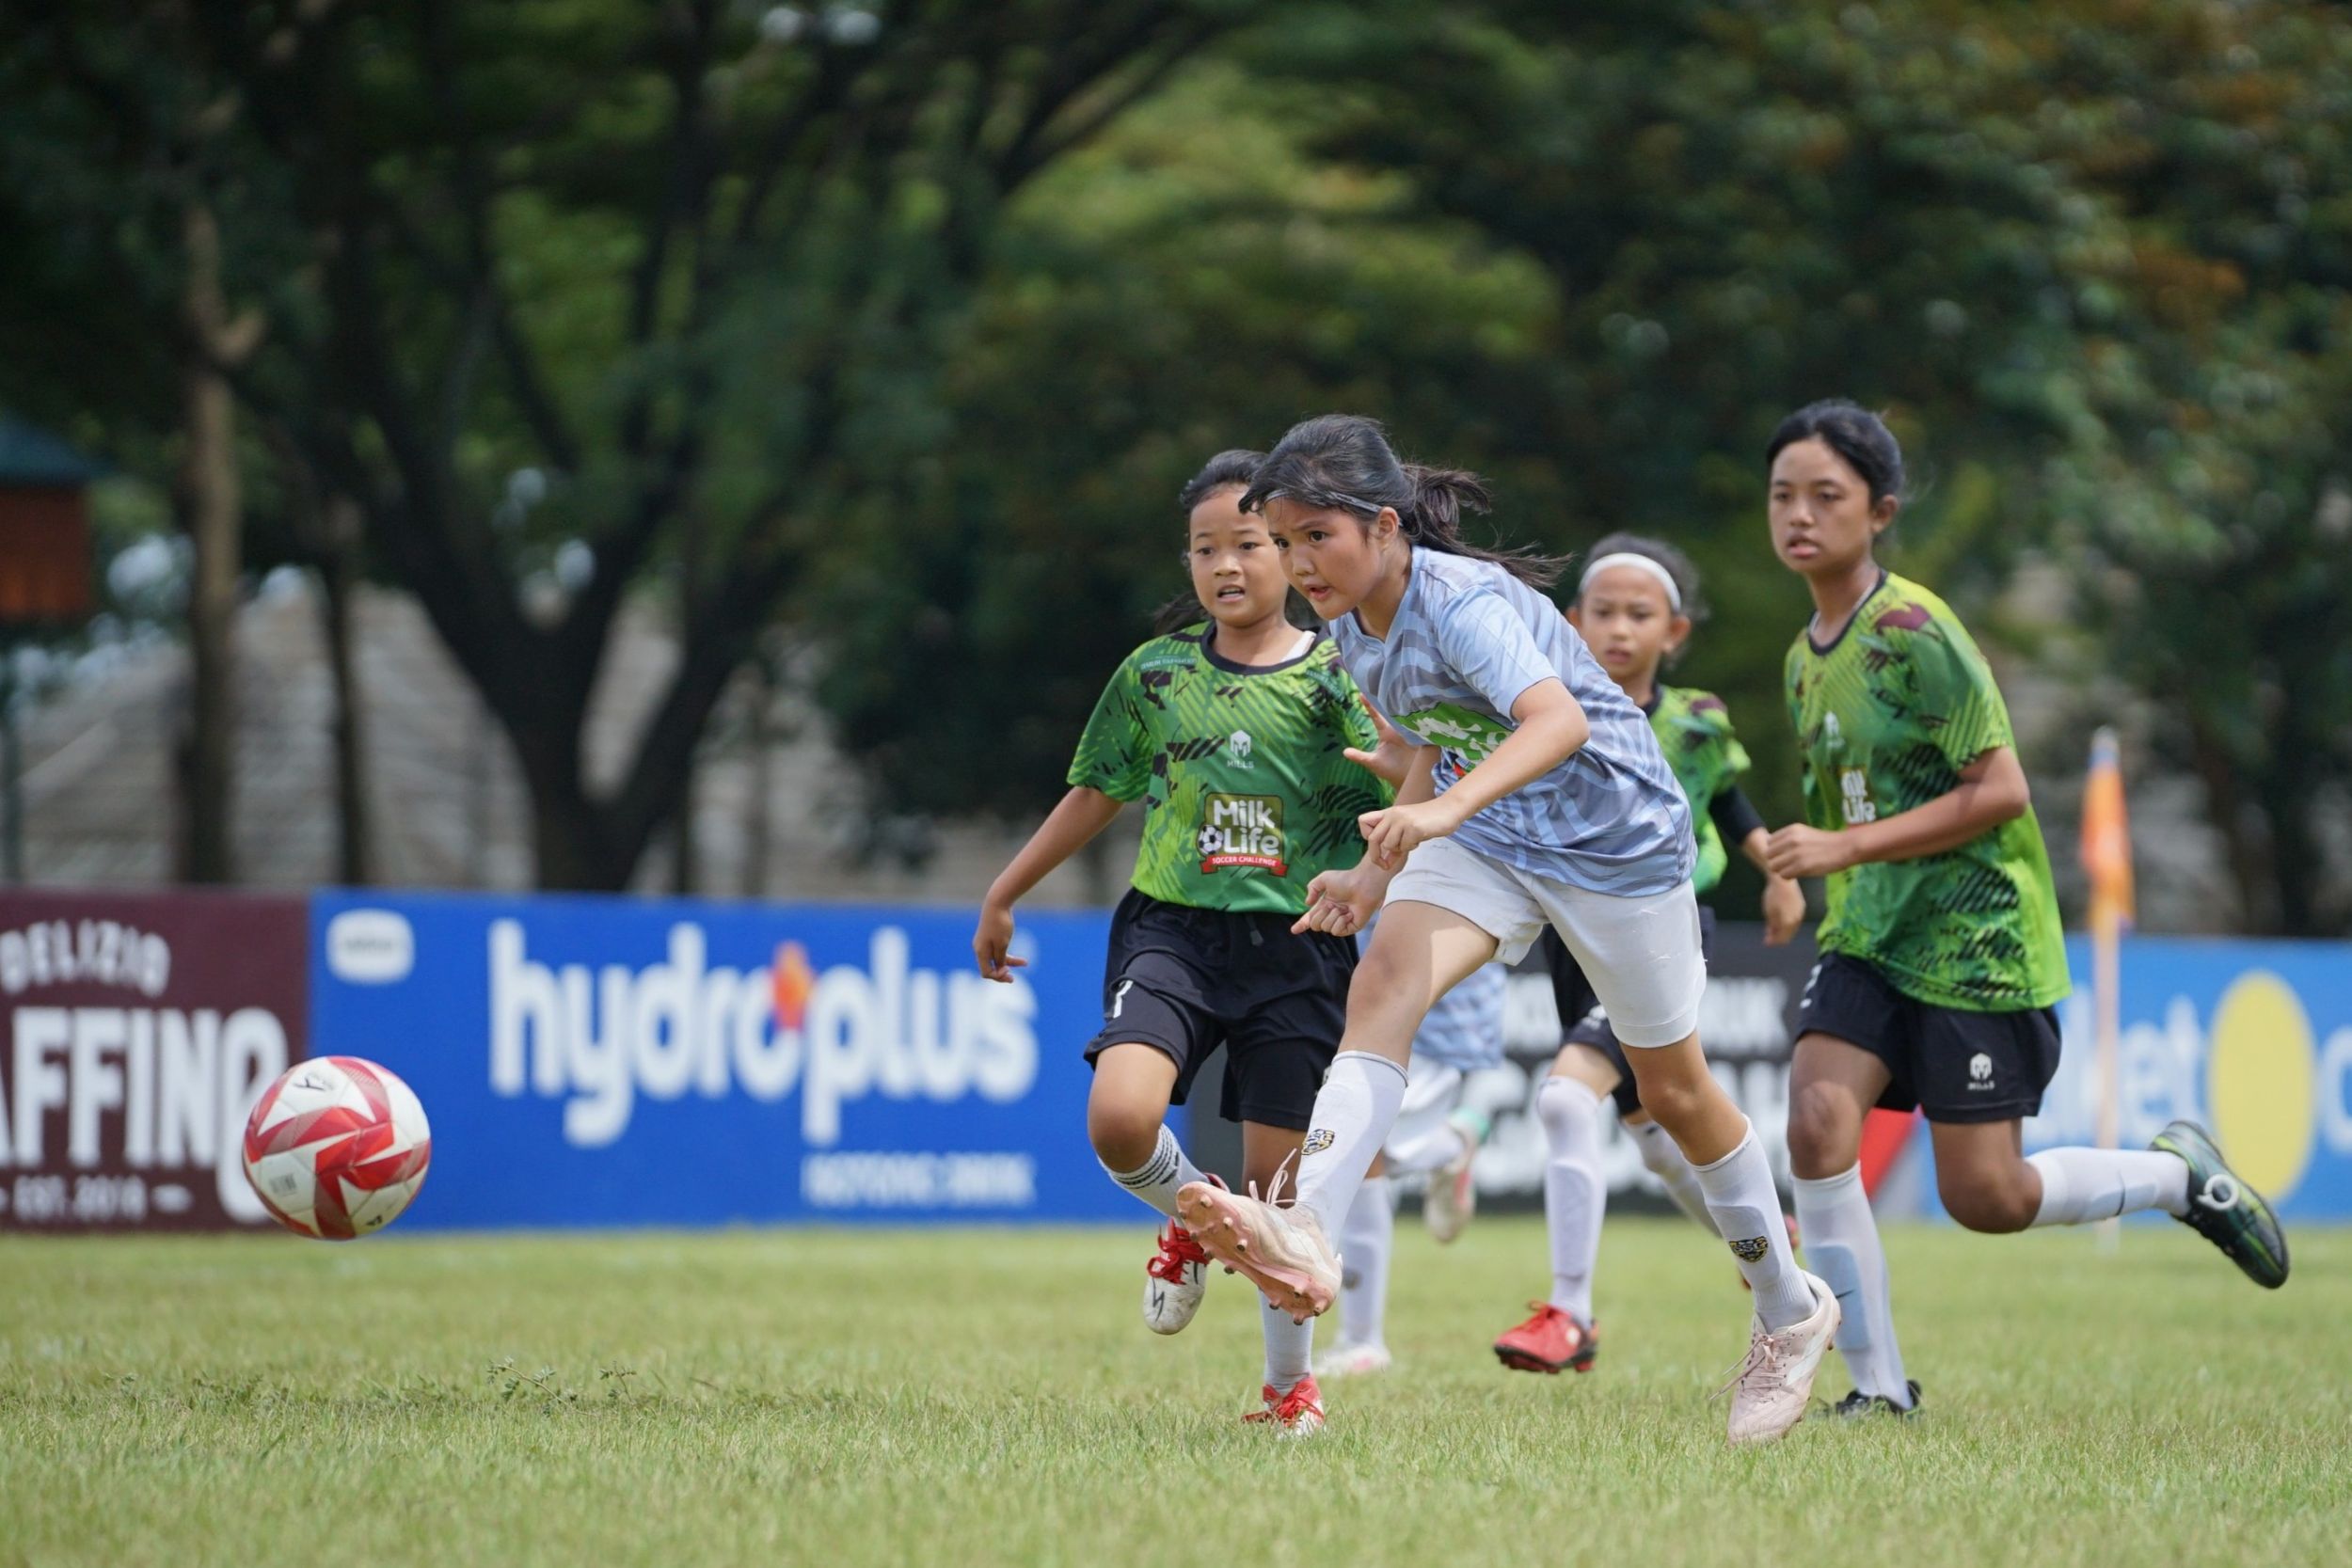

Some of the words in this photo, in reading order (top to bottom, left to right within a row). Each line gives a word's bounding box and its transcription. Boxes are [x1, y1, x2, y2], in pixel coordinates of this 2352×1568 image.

[1214, 800, 1276, 829] Milk
[1223, 828, 1280, 856] Life
[1212, 856, 1238, 864] SOCCER
[1239, 856, 1276, 866] CHALLENGE
[488, 918, 1038, 1147] hydroplus
[0, 1006, 288, 1223] FFINO
